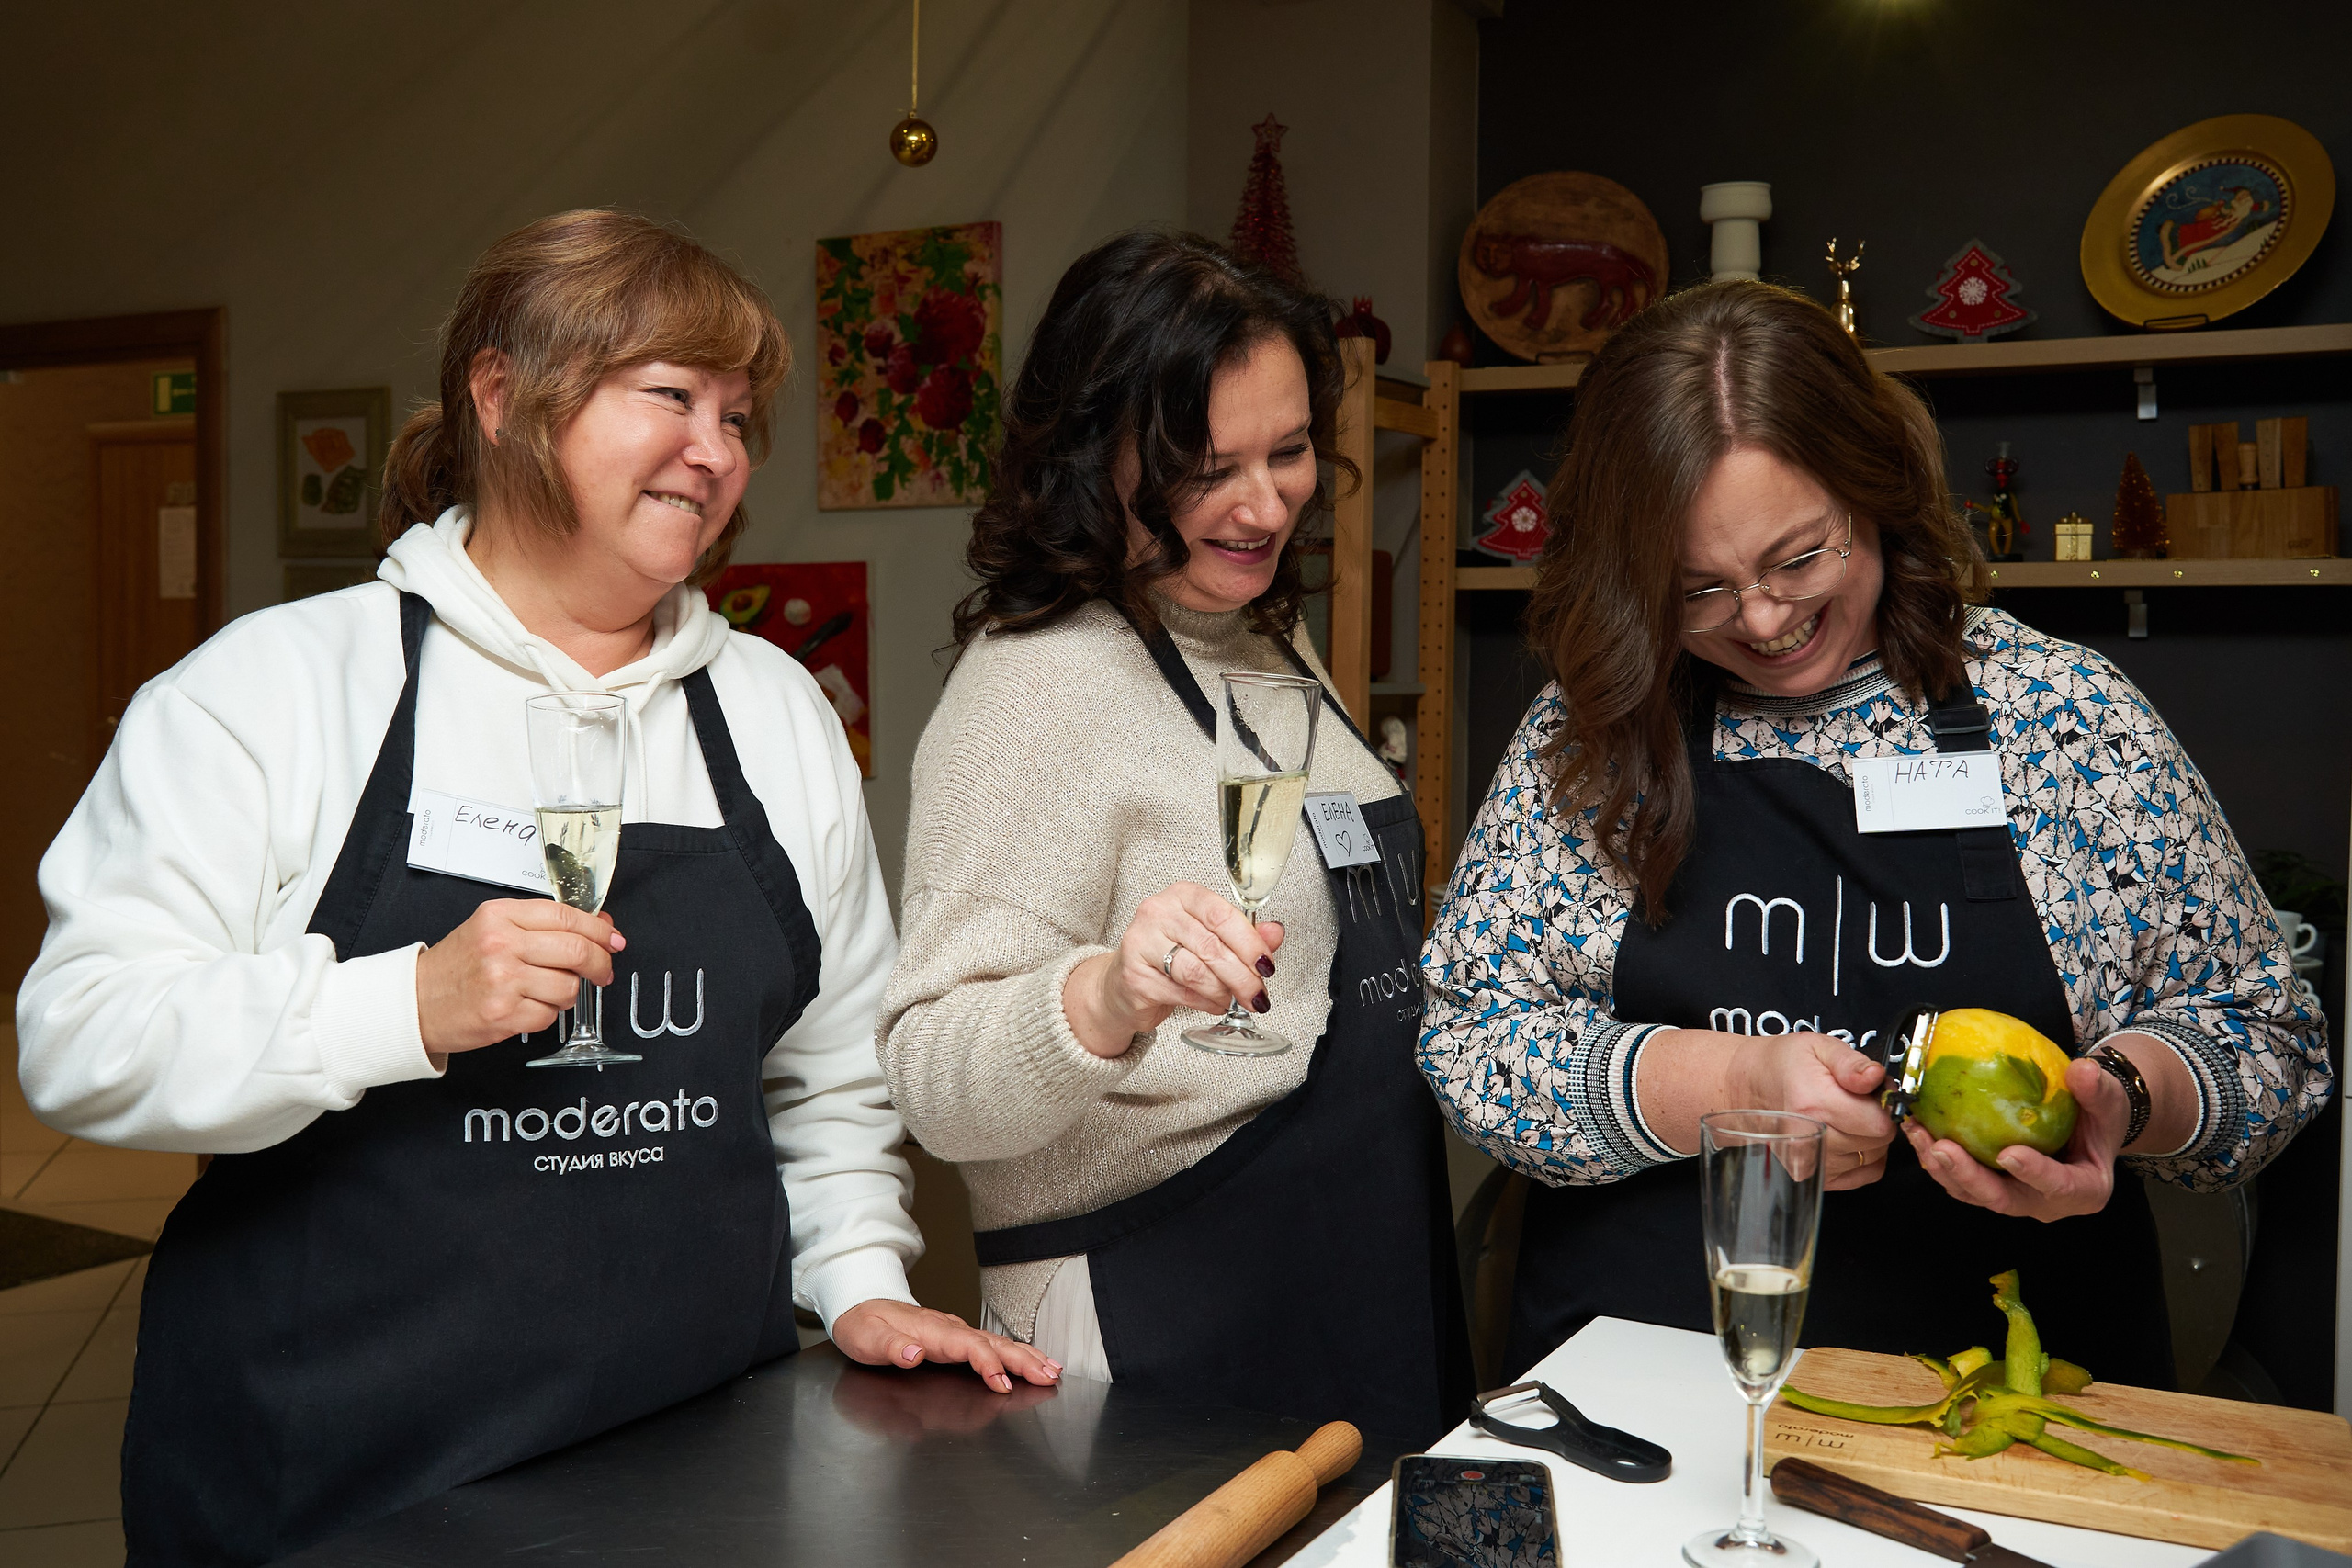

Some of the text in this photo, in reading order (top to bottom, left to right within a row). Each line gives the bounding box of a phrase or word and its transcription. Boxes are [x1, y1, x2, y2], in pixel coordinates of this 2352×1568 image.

[1894, 760, 1969, 784] НАТА
[1861, 775, 1871, 812] moderato
[454, 805, 537, 846] Елена
[1320, 801, 1354, 822] ЕЛЕНА
[419, 809, 432, 847] moderato
[521, 870, 547, 881] COOK
[464, 1089, 719, 1143] moderato
[533, 1145, 664, 1176] студия вкуса
[1777, 1424, 1855, 1438] moderato
